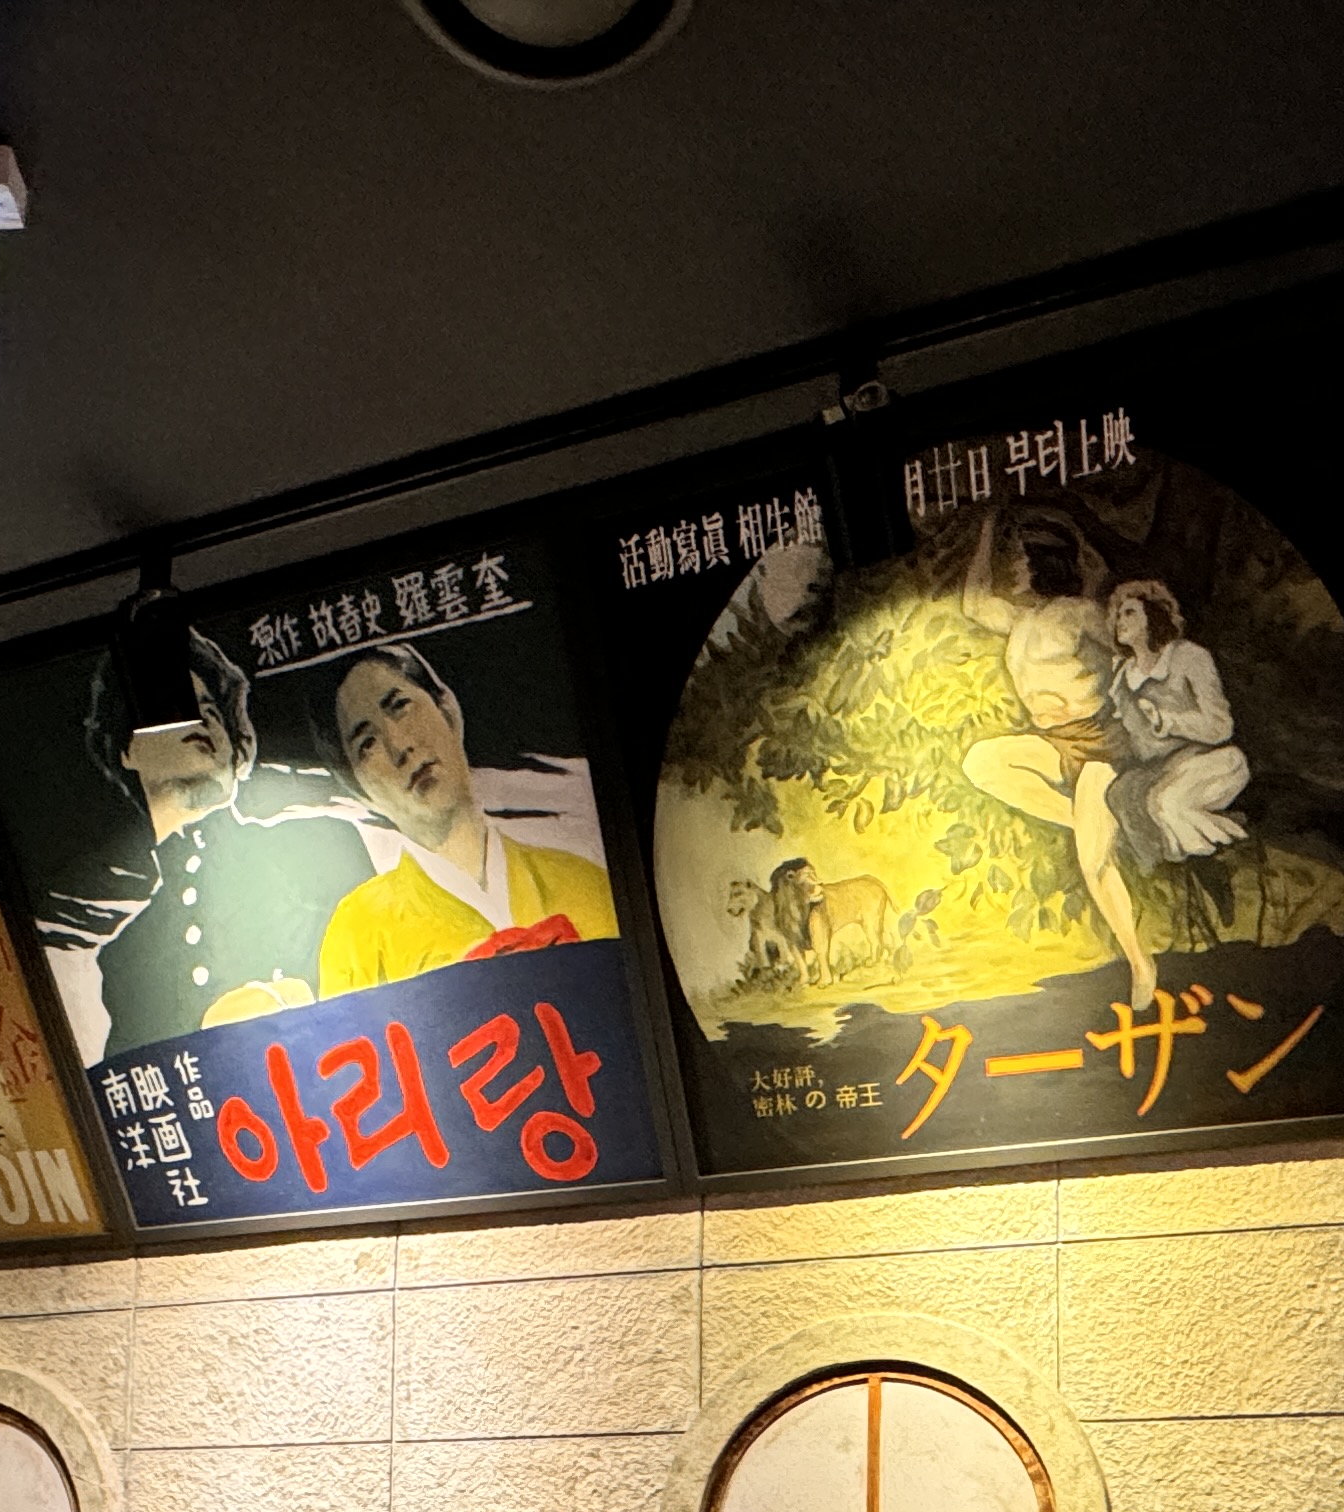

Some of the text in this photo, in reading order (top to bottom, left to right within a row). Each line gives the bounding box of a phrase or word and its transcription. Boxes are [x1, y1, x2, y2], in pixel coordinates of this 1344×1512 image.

[216, 1001, 602, 1194] 아리랑
[896, 983, 1325, 1140] ターザン
